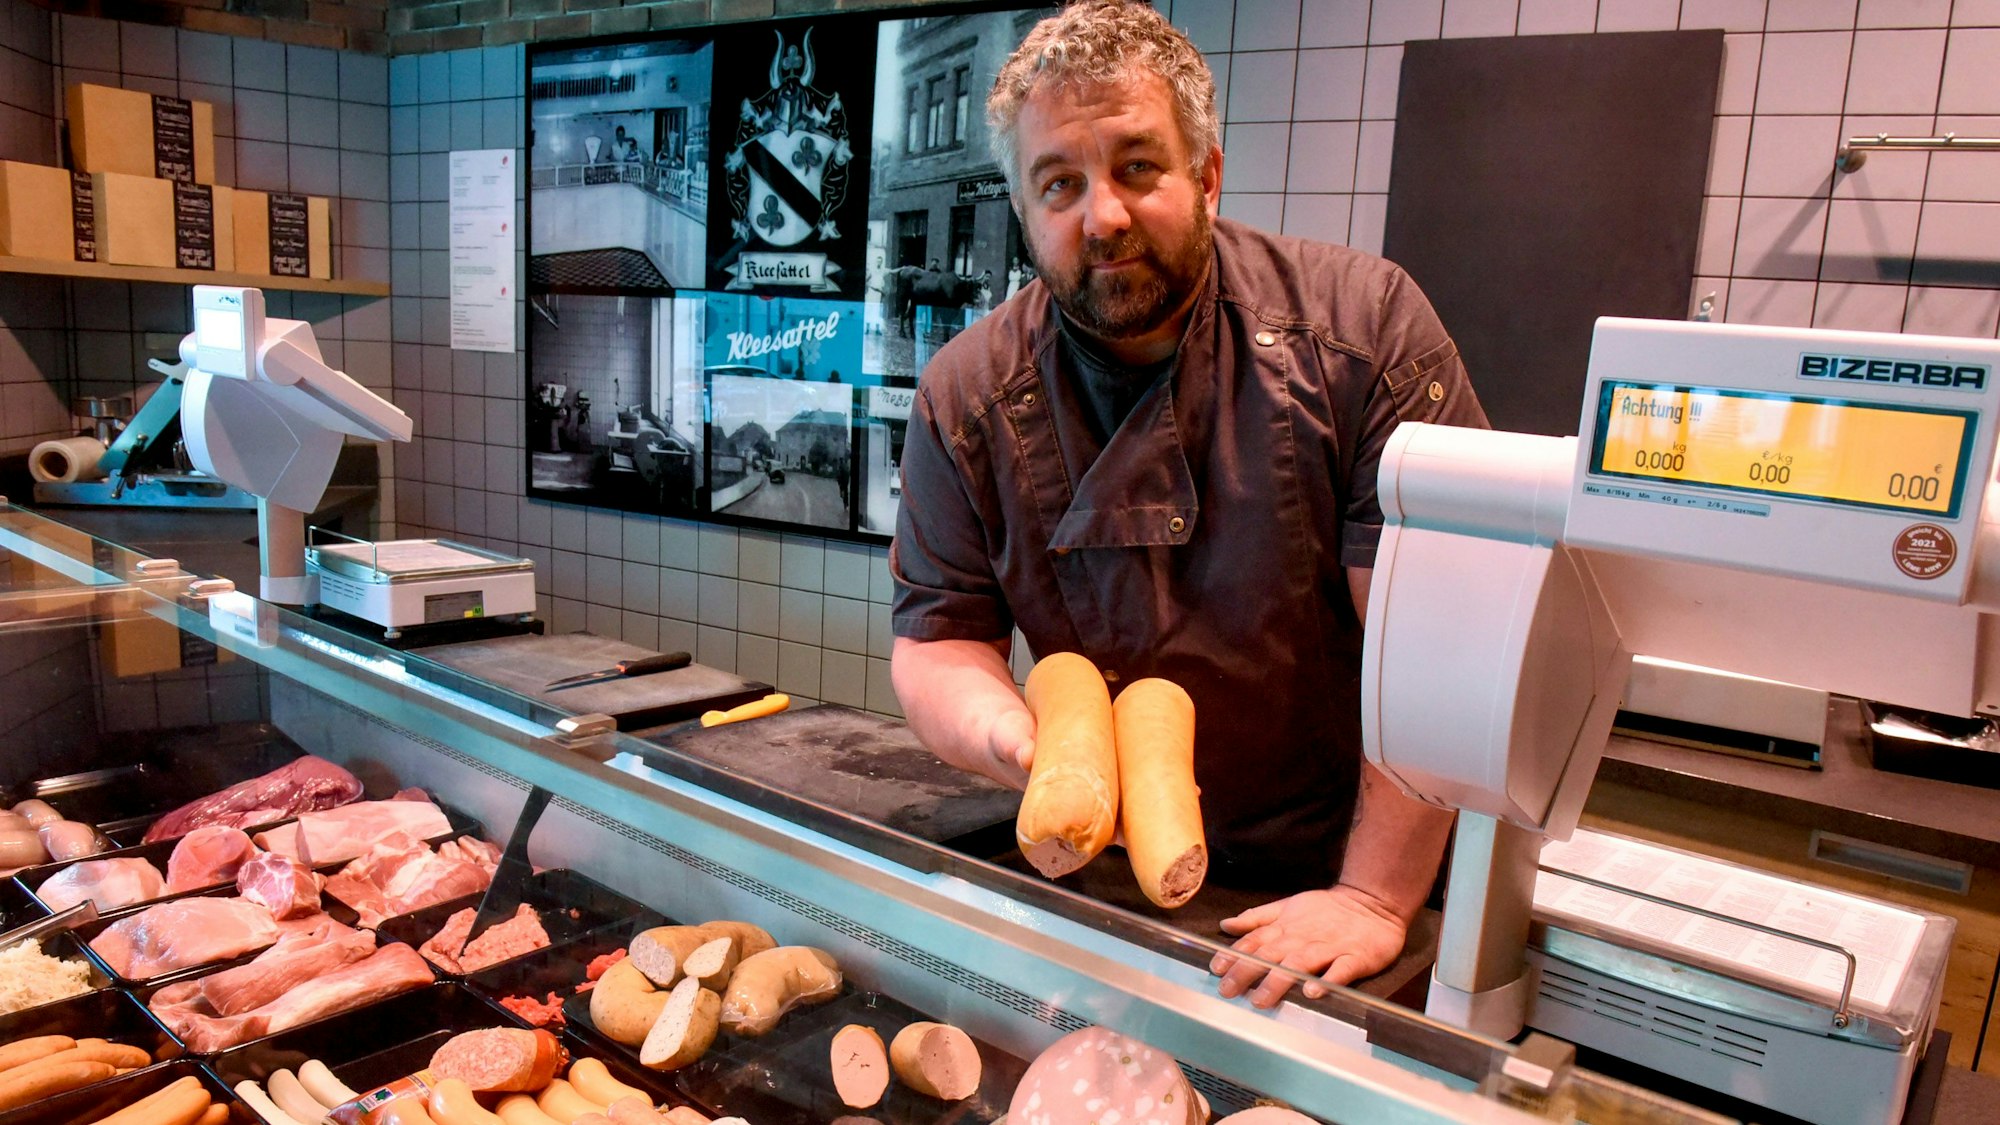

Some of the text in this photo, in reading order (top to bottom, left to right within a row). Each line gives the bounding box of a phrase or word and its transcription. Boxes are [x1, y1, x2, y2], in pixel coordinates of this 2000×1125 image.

[726, 311, 840, 363] Kleesattel
[1800, 355, 1986, 390] BIZERBA
[1621, 396, 1684, 424] Achtung
[1672, 441, 1687, 454] kg
[1761, 451, 1793, 466] €/kg
[1634, 449, 1685, 472] 0,000
[1934, 463, 1943, 474] €
[1749, 462, 1791, 485] 0,00
[1638, 491, 1650, 500] Min
[1888, 472, 1940, 502] 0,00
[1910, 538, 1936, 547] 2021
